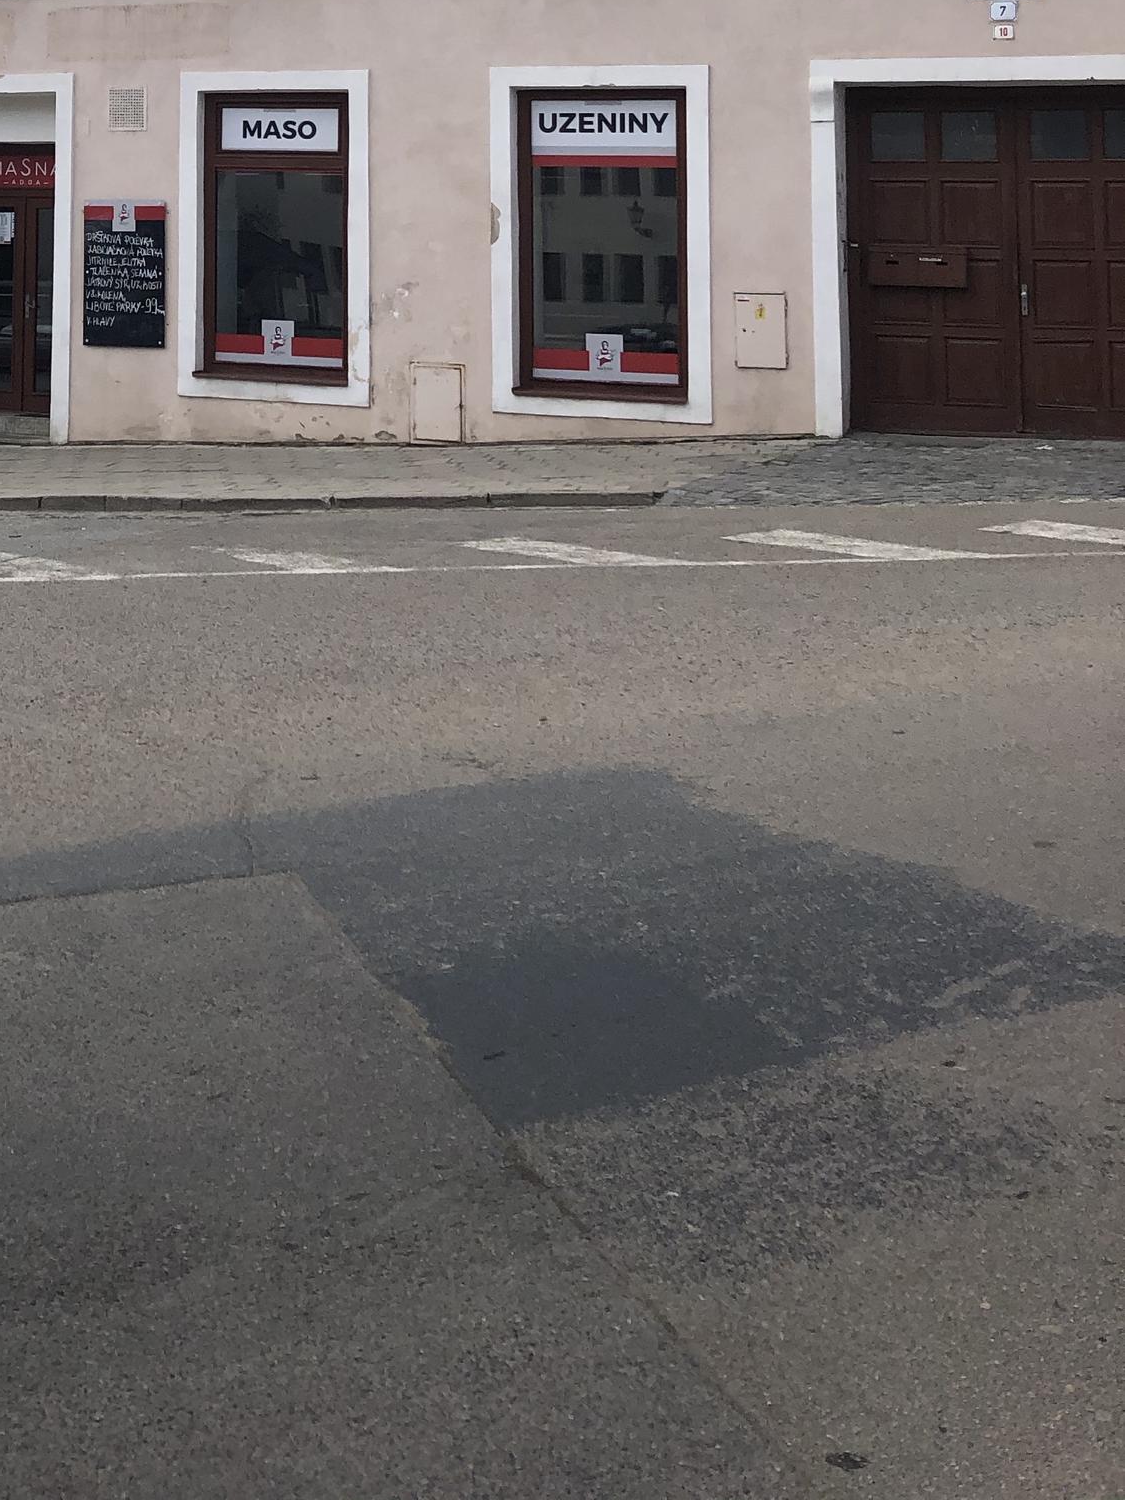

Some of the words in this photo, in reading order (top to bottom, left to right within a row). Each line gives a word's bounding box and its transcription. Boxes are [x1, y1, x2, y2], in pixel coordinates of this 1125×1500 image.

[999, 5, 1007, 17] 7
[999, 27, 1008, 37] 10
[242, 120, 317, 140] MASO
[538, 112, 669, 134] UZENINY
